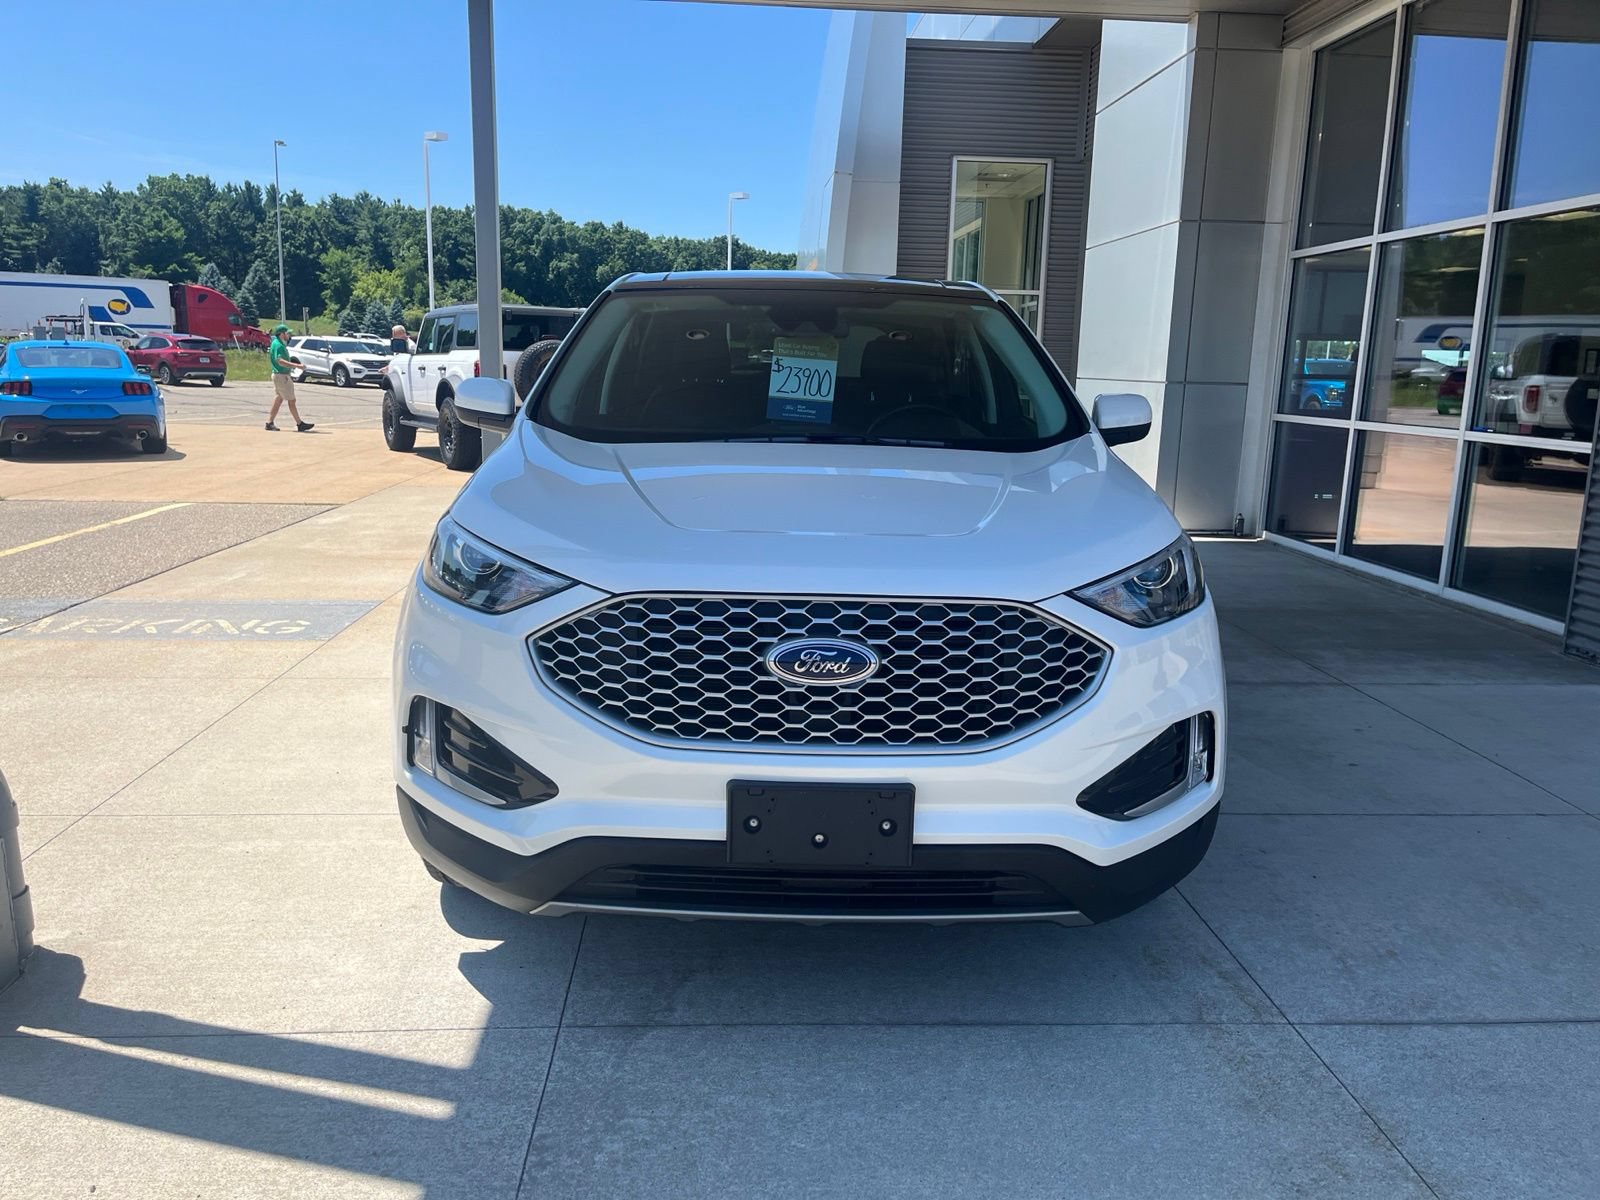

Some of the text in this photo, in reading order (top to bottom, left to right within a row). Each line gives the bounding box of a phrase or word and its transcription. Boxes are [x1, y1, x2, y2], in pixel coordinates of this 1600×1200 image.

[772, 357, 832, 397] $23900
[0, 617, 311, 634] ARKING
[794, 649, 852, 674] Ford
